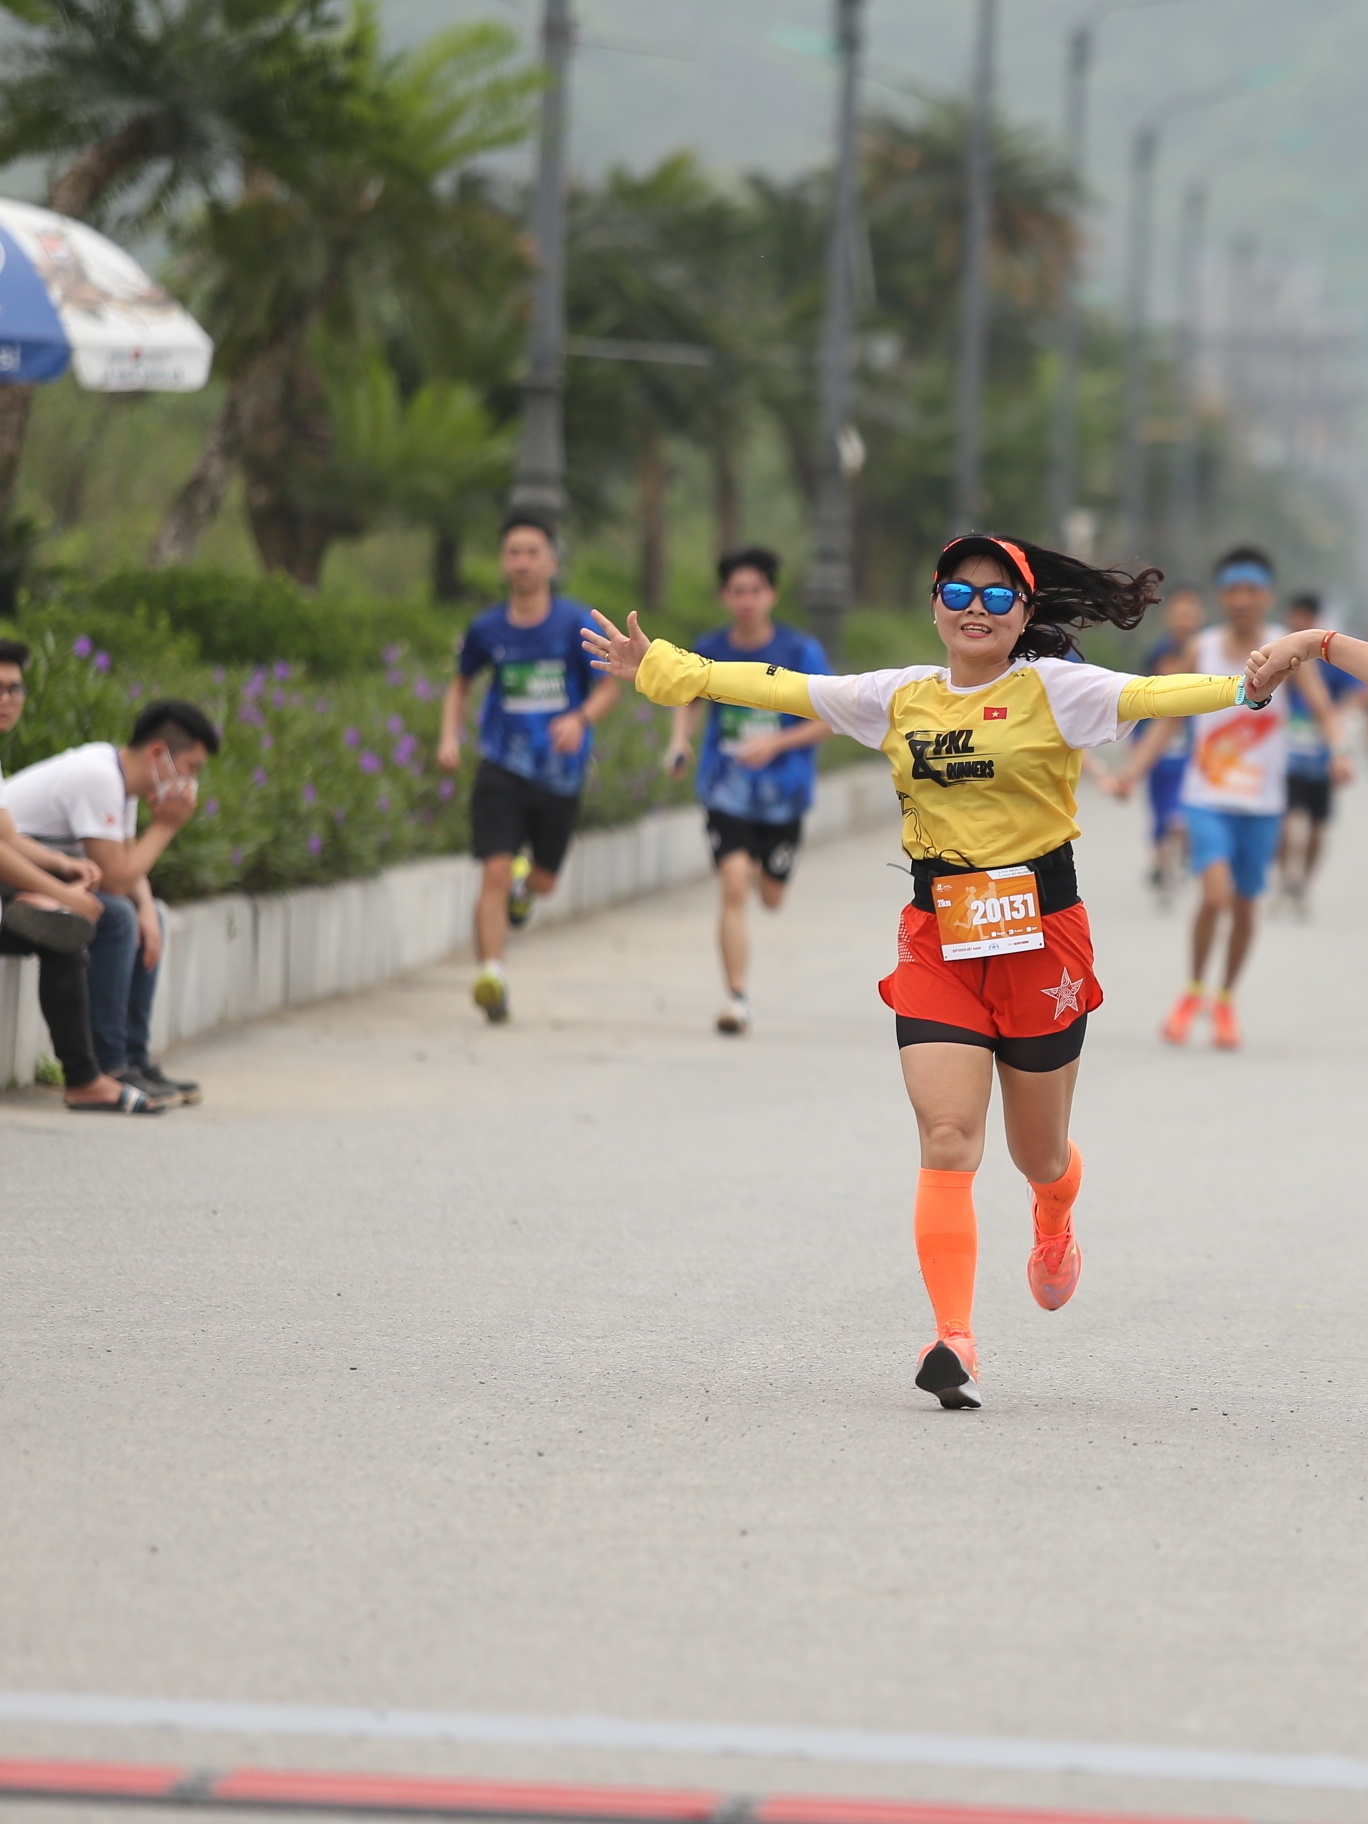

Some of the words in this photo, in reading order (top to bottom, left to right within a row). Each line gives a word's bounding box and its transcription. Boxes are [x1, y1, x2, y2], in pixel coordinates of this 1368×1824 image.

[933, 730, 974, 755] VKL
[946, 760, 995, 780] RUNNERS
[970, 892, 1036, 926] 20131
